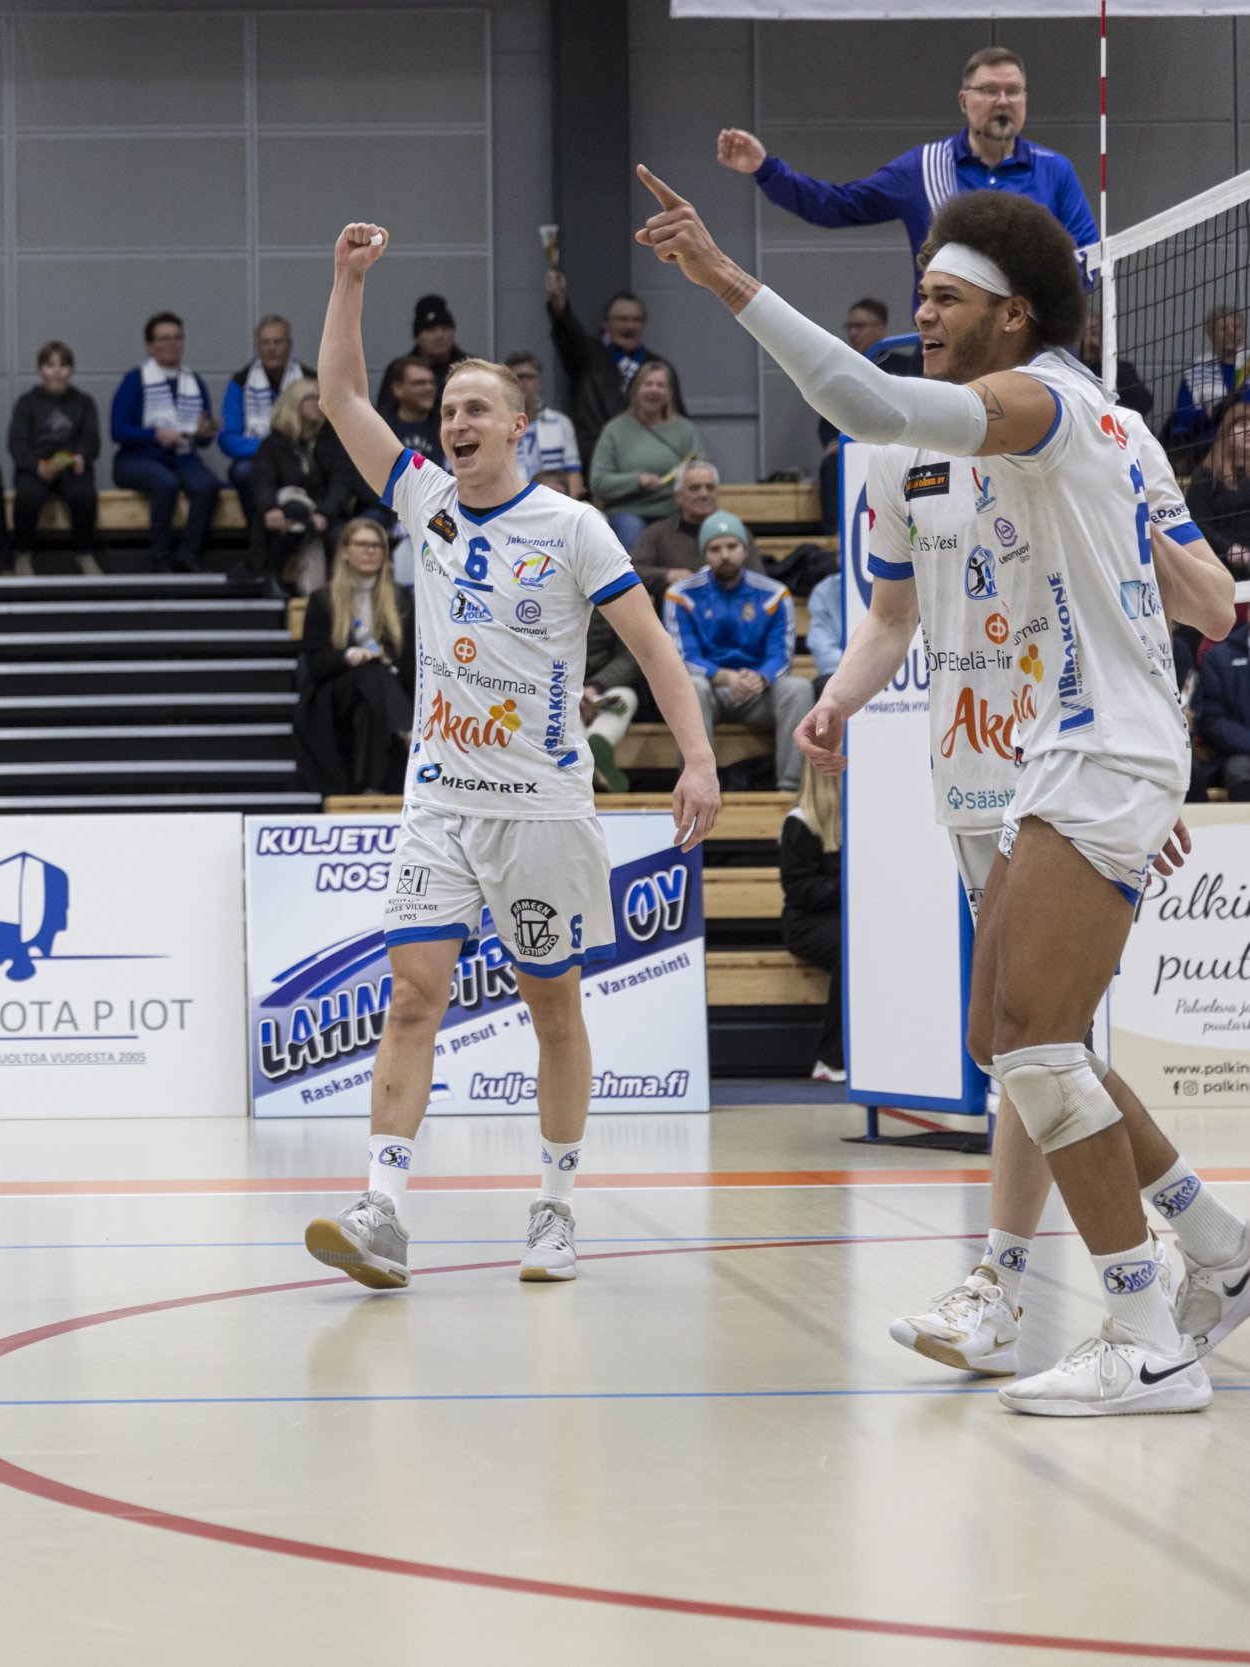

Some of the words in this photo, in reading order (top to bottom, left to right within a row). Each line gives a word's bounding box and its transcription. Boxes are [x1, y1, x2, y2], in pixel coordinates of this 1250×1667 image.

[464, 536, 491, 581] 6
[442, 775, 538, 794] MEGATREX
[316, 862, 392, 892] NOS
[597, 951, 692, 998] Varastointi
[451, 1023, 498, 1054] pesut
[49, 1051, 116, 1064] VUODESTA
[118, 1051, 147, 1063] 2005
